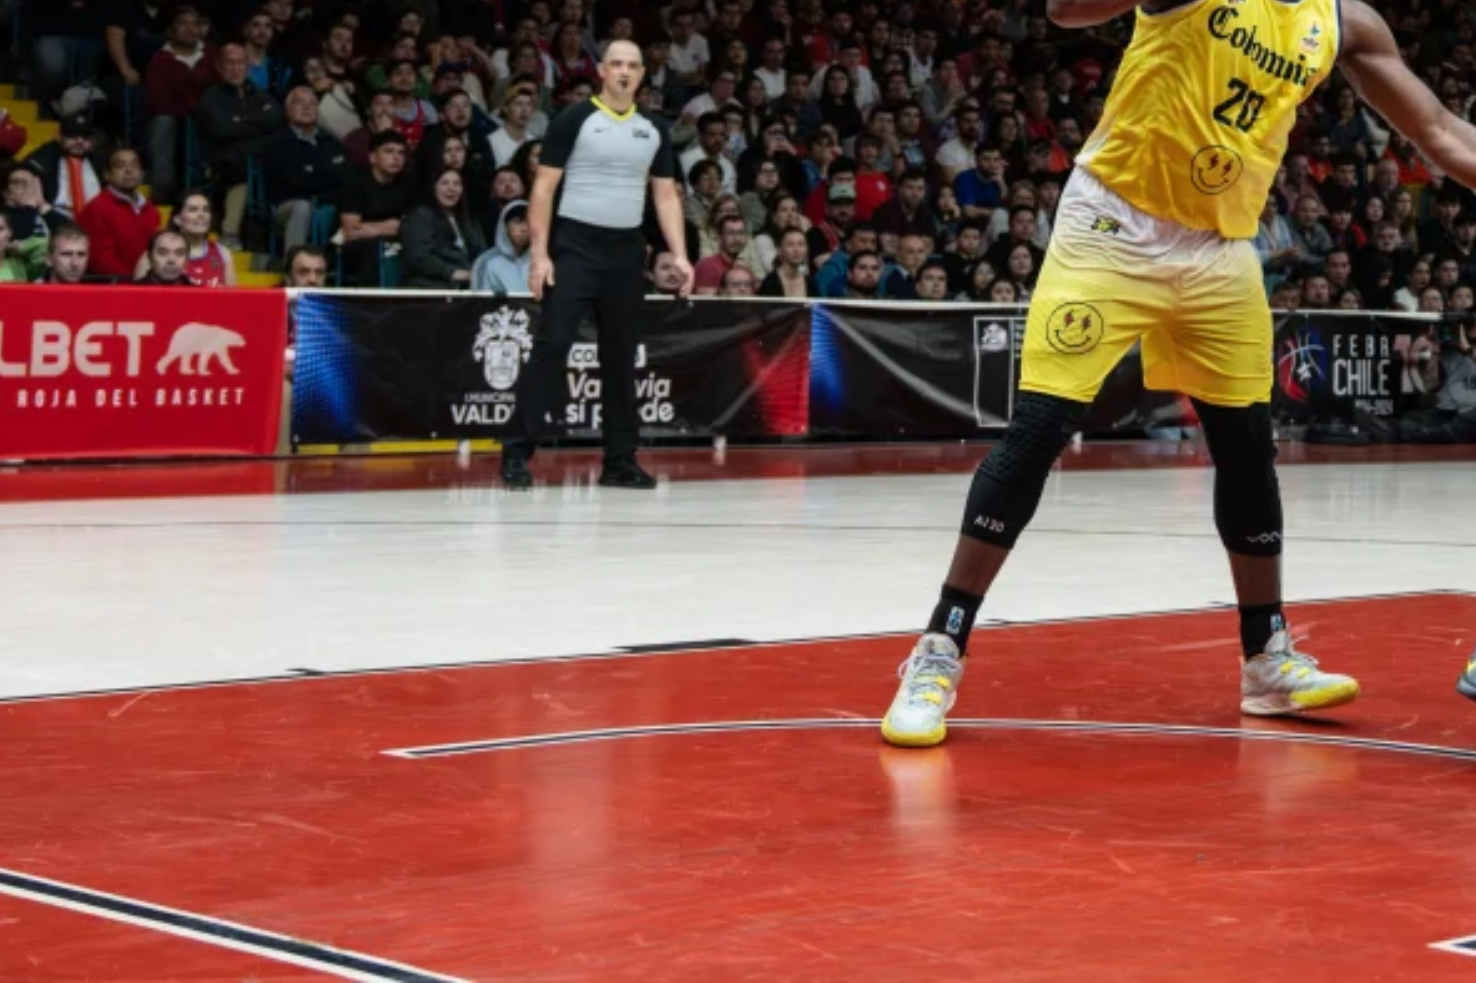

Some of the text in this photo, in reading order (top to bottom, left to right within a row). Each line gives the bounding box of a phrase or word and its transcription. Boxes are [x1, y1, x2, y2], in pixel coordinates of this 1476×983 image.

[1213, 77, 1265, 133] 20
[1332, 334, 1390, 358] FEBA
[1332, 359, 1391, 396] CHILE
[17, 387, 244, 408] ROJA DEL BASKET
